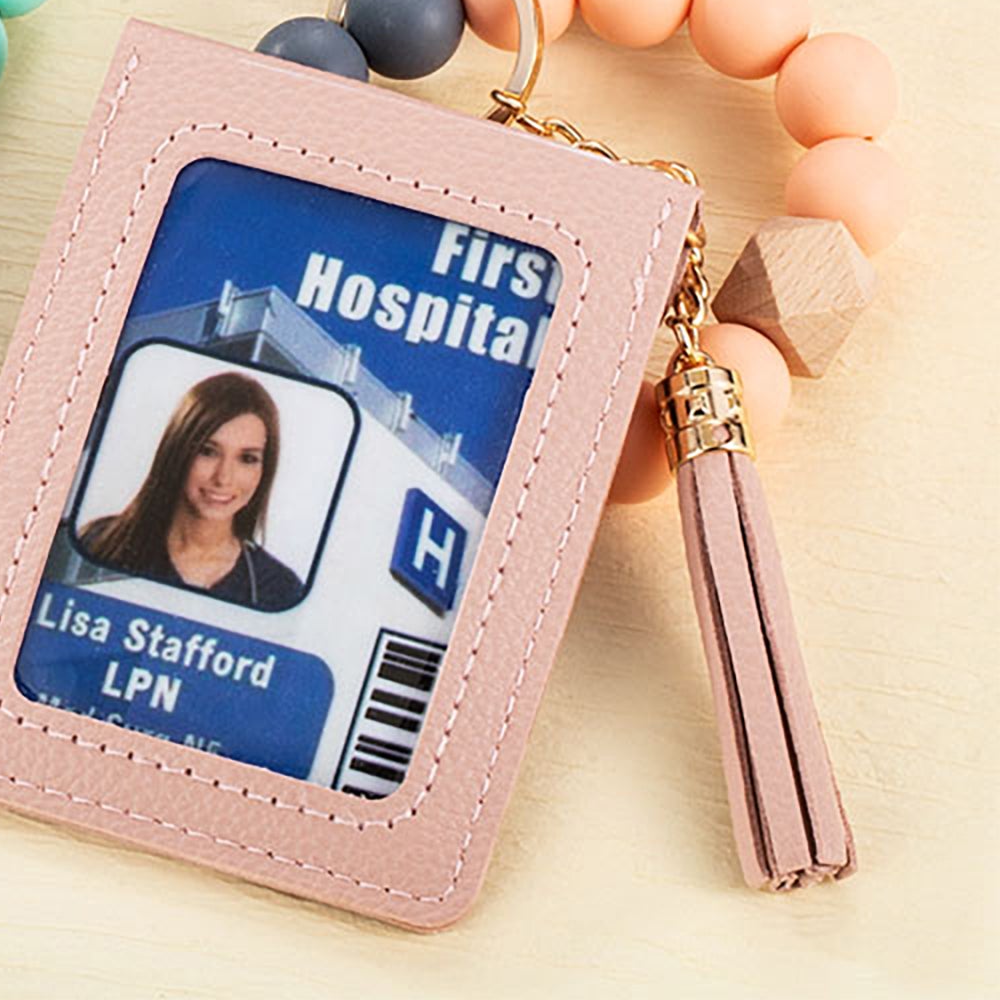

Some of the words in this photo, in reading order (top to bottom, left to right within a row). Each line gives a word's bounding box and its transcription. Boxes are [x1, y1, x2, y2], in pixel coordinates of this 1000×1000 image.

[412, 507, 457, 590] H
[36, 593, 112, 644] Lisa
[123, 617, 276, 690] Stafford
[102, 661, 183, 714] LPN
